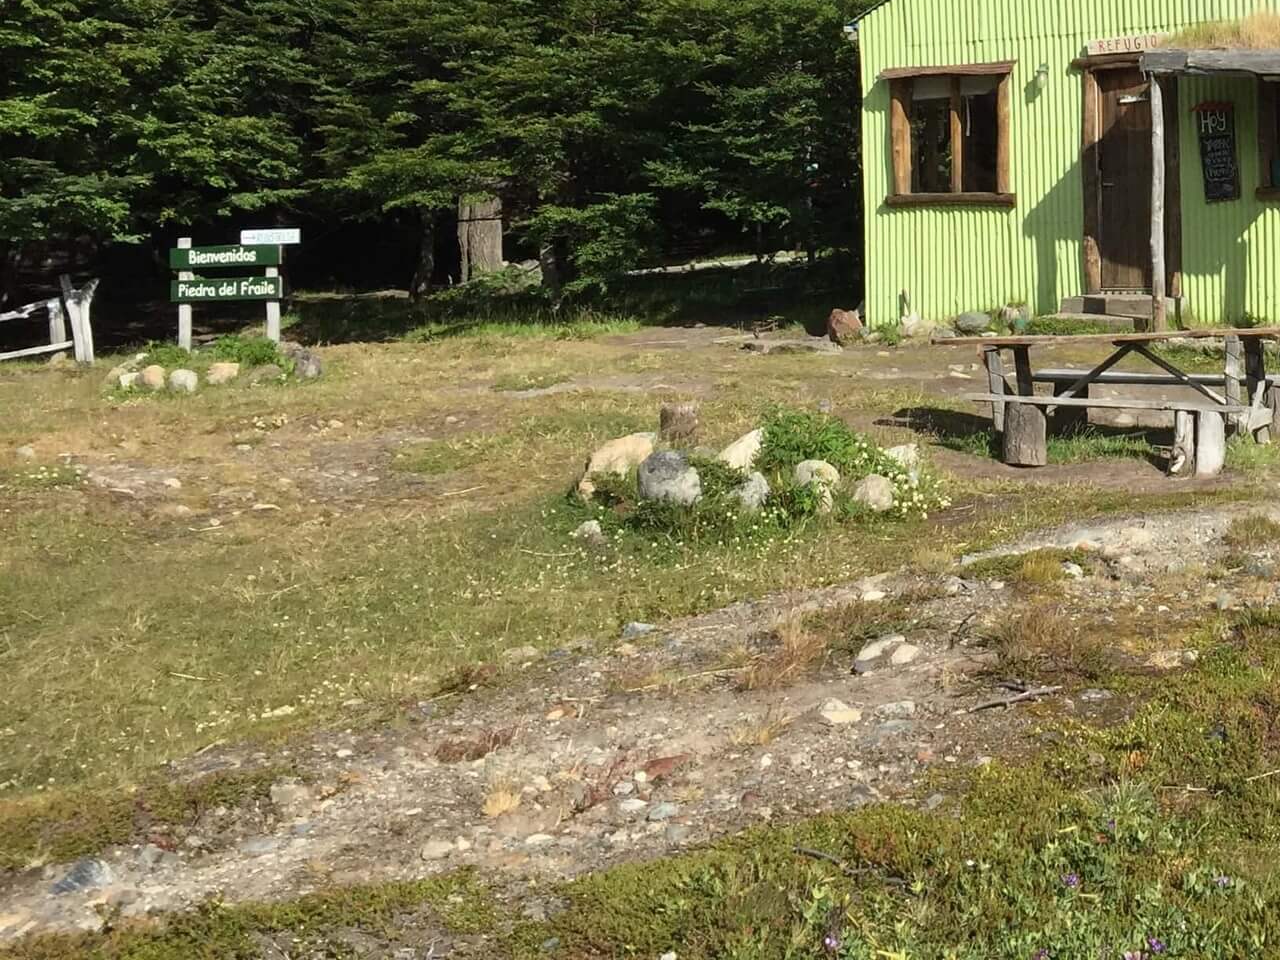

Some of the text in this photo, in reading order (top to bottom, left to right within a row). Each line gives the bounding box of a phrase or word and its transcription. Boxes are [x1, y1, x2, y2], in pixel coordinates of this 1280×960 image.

[1098, 35, 1157, 52] REFUGIO
[188, 247, 257, 264] Bienvenidos
[178, 283, 216, 298] Piedra
[218, 281, 237, 296] del
